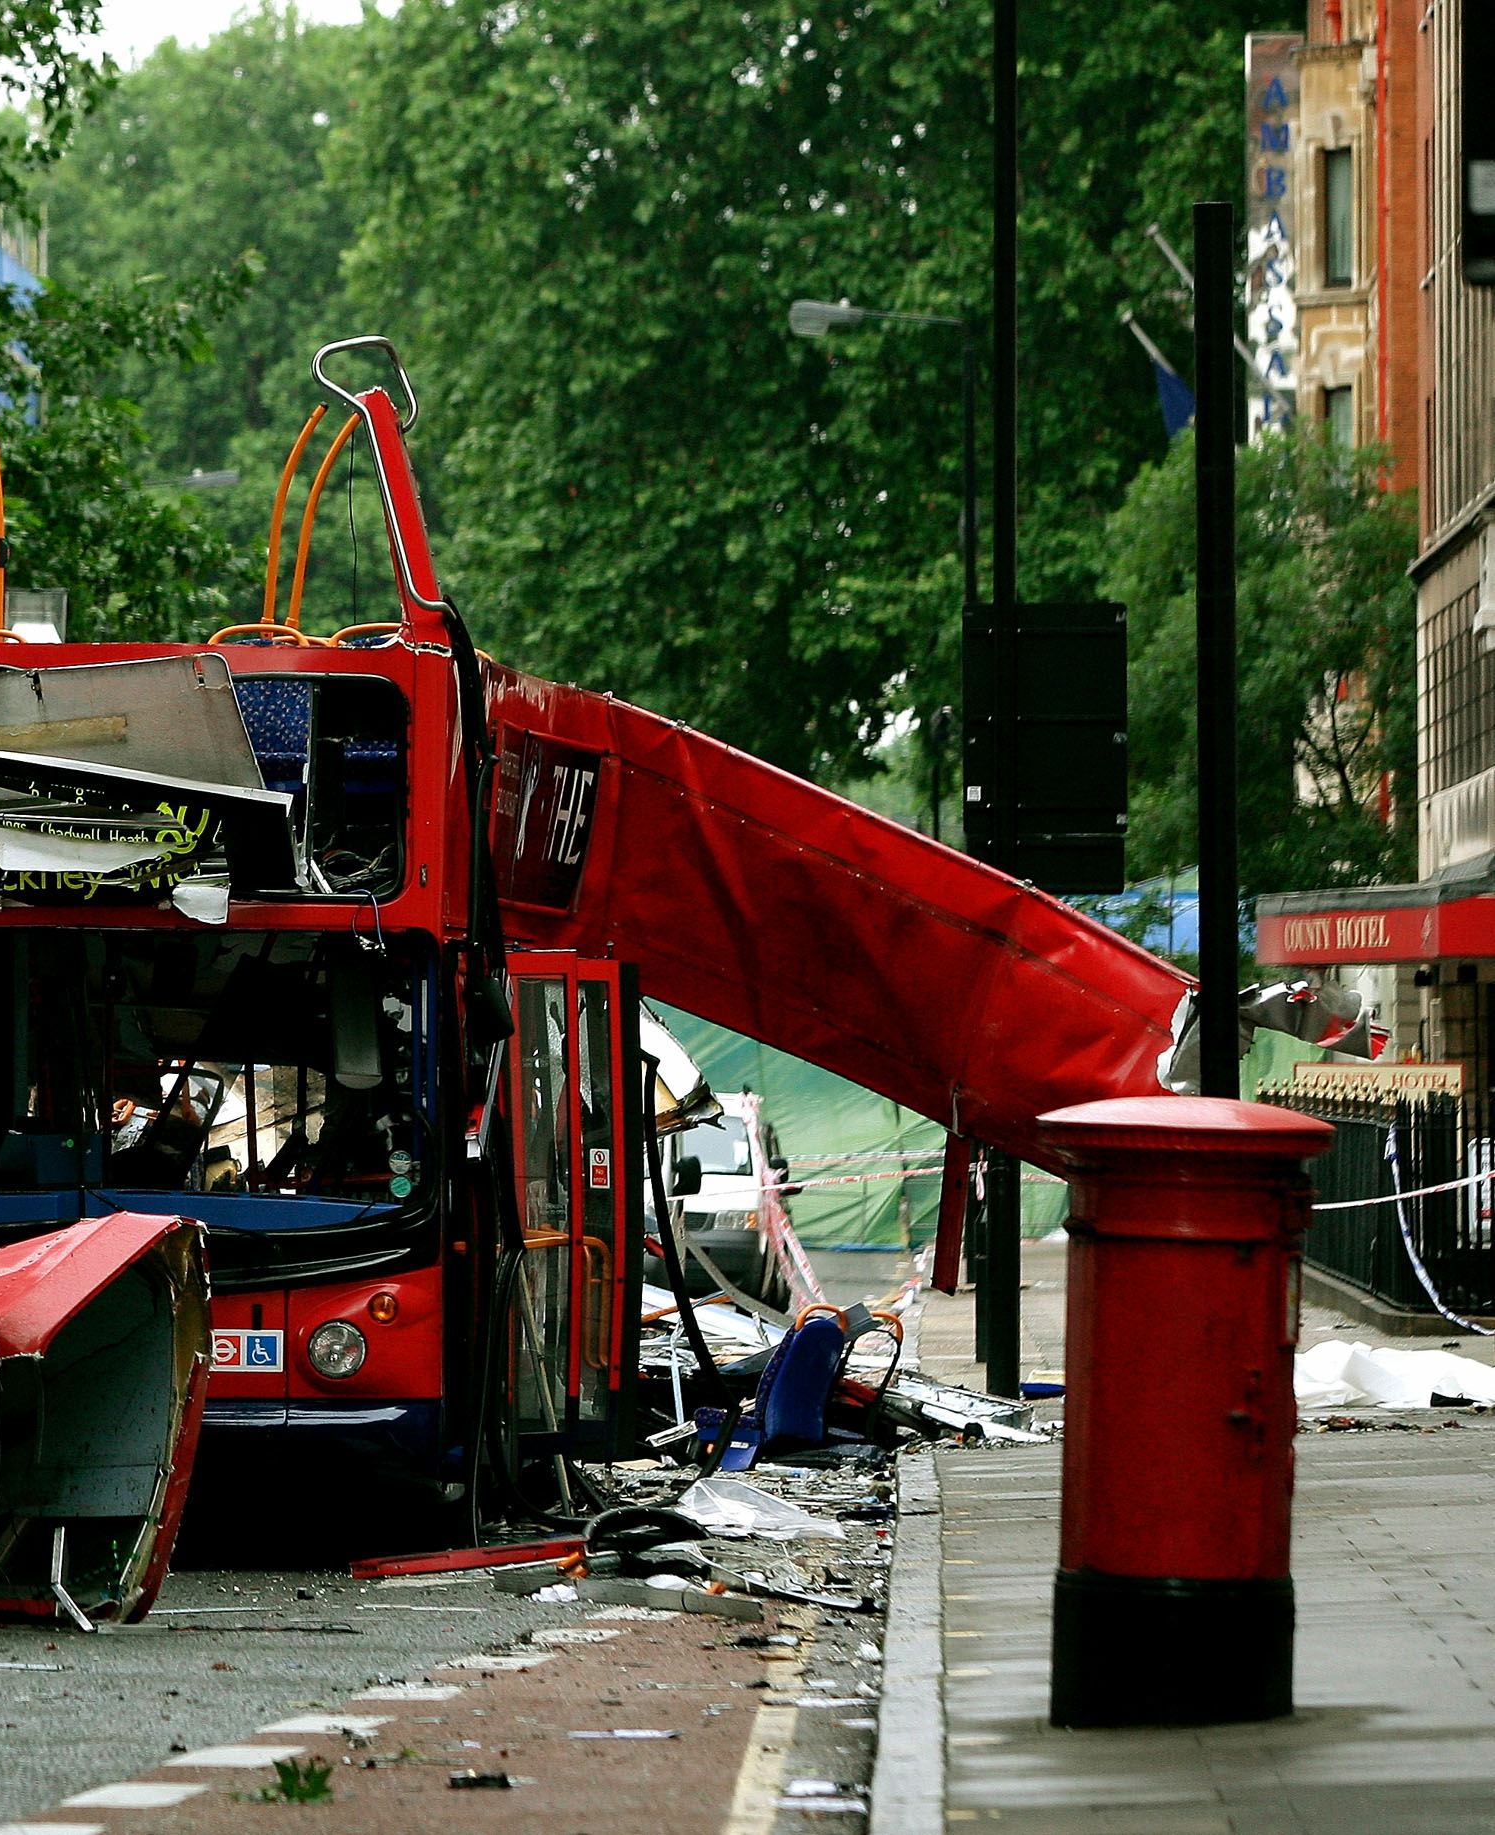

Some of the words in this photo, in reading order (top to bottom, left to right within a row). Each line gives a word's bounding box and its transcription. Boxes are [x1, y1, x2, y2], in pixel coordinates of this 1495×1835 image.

[1284, 917, 1332, 952] COUNTY
[1336, 915, 1390, 949] HOTEL
[1392, 1072, 1452, 1090] HOTEL
